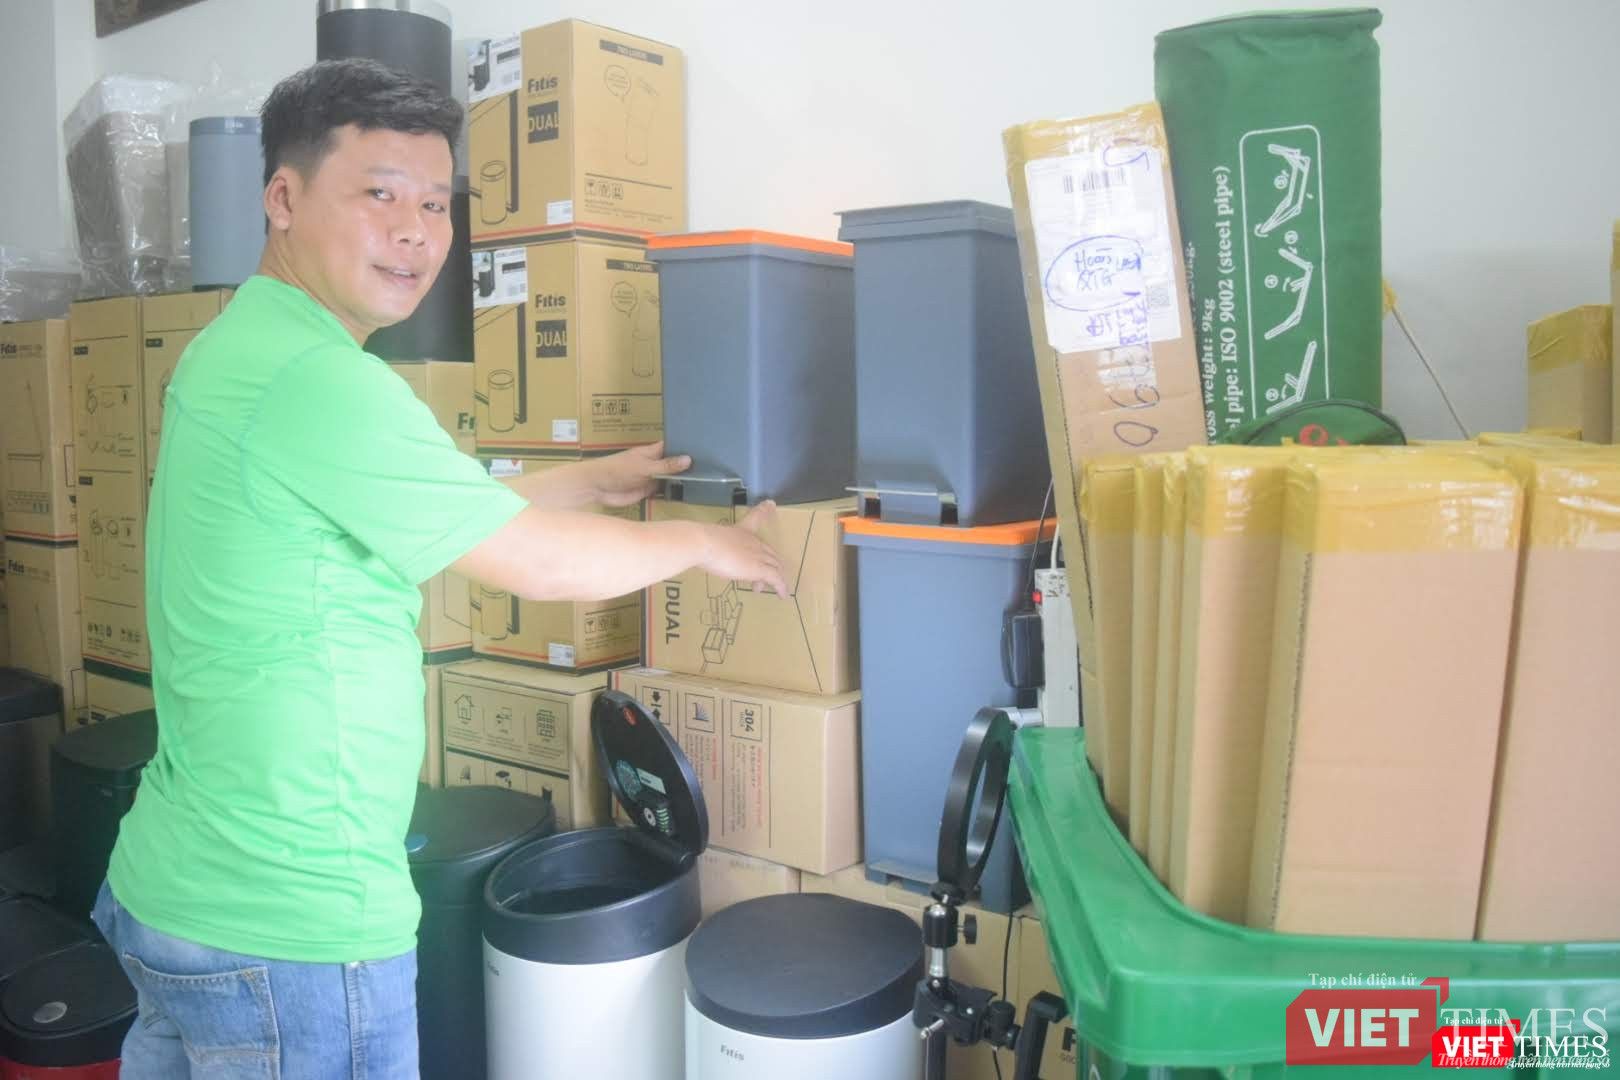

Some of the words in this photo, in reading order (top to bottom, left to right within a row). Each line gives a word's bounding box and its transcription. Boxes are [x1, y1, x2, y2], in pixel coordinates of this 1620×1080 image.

[528, 75, 558, 93] Fitis
[528, 112, 559, 134] DUAL
[1213, 165, 1234, 216] pipe)
[1216, 219, 1235, 274] (steel
[536, 294, 566, 309] Fitis
[1201, 298, 1215, 334] 9kg
[1218, 277, 1236, 323] 9002
[536, 331, 567, 347] DUAL
[1221, 327, 1238, 363] ISO
[1201, 336, 1217, 405] weight:
[1224, 367, 1244, 412] pipe:
[665, 586, 680, 645] DUAL
[745, 709, 755, 732] 304
